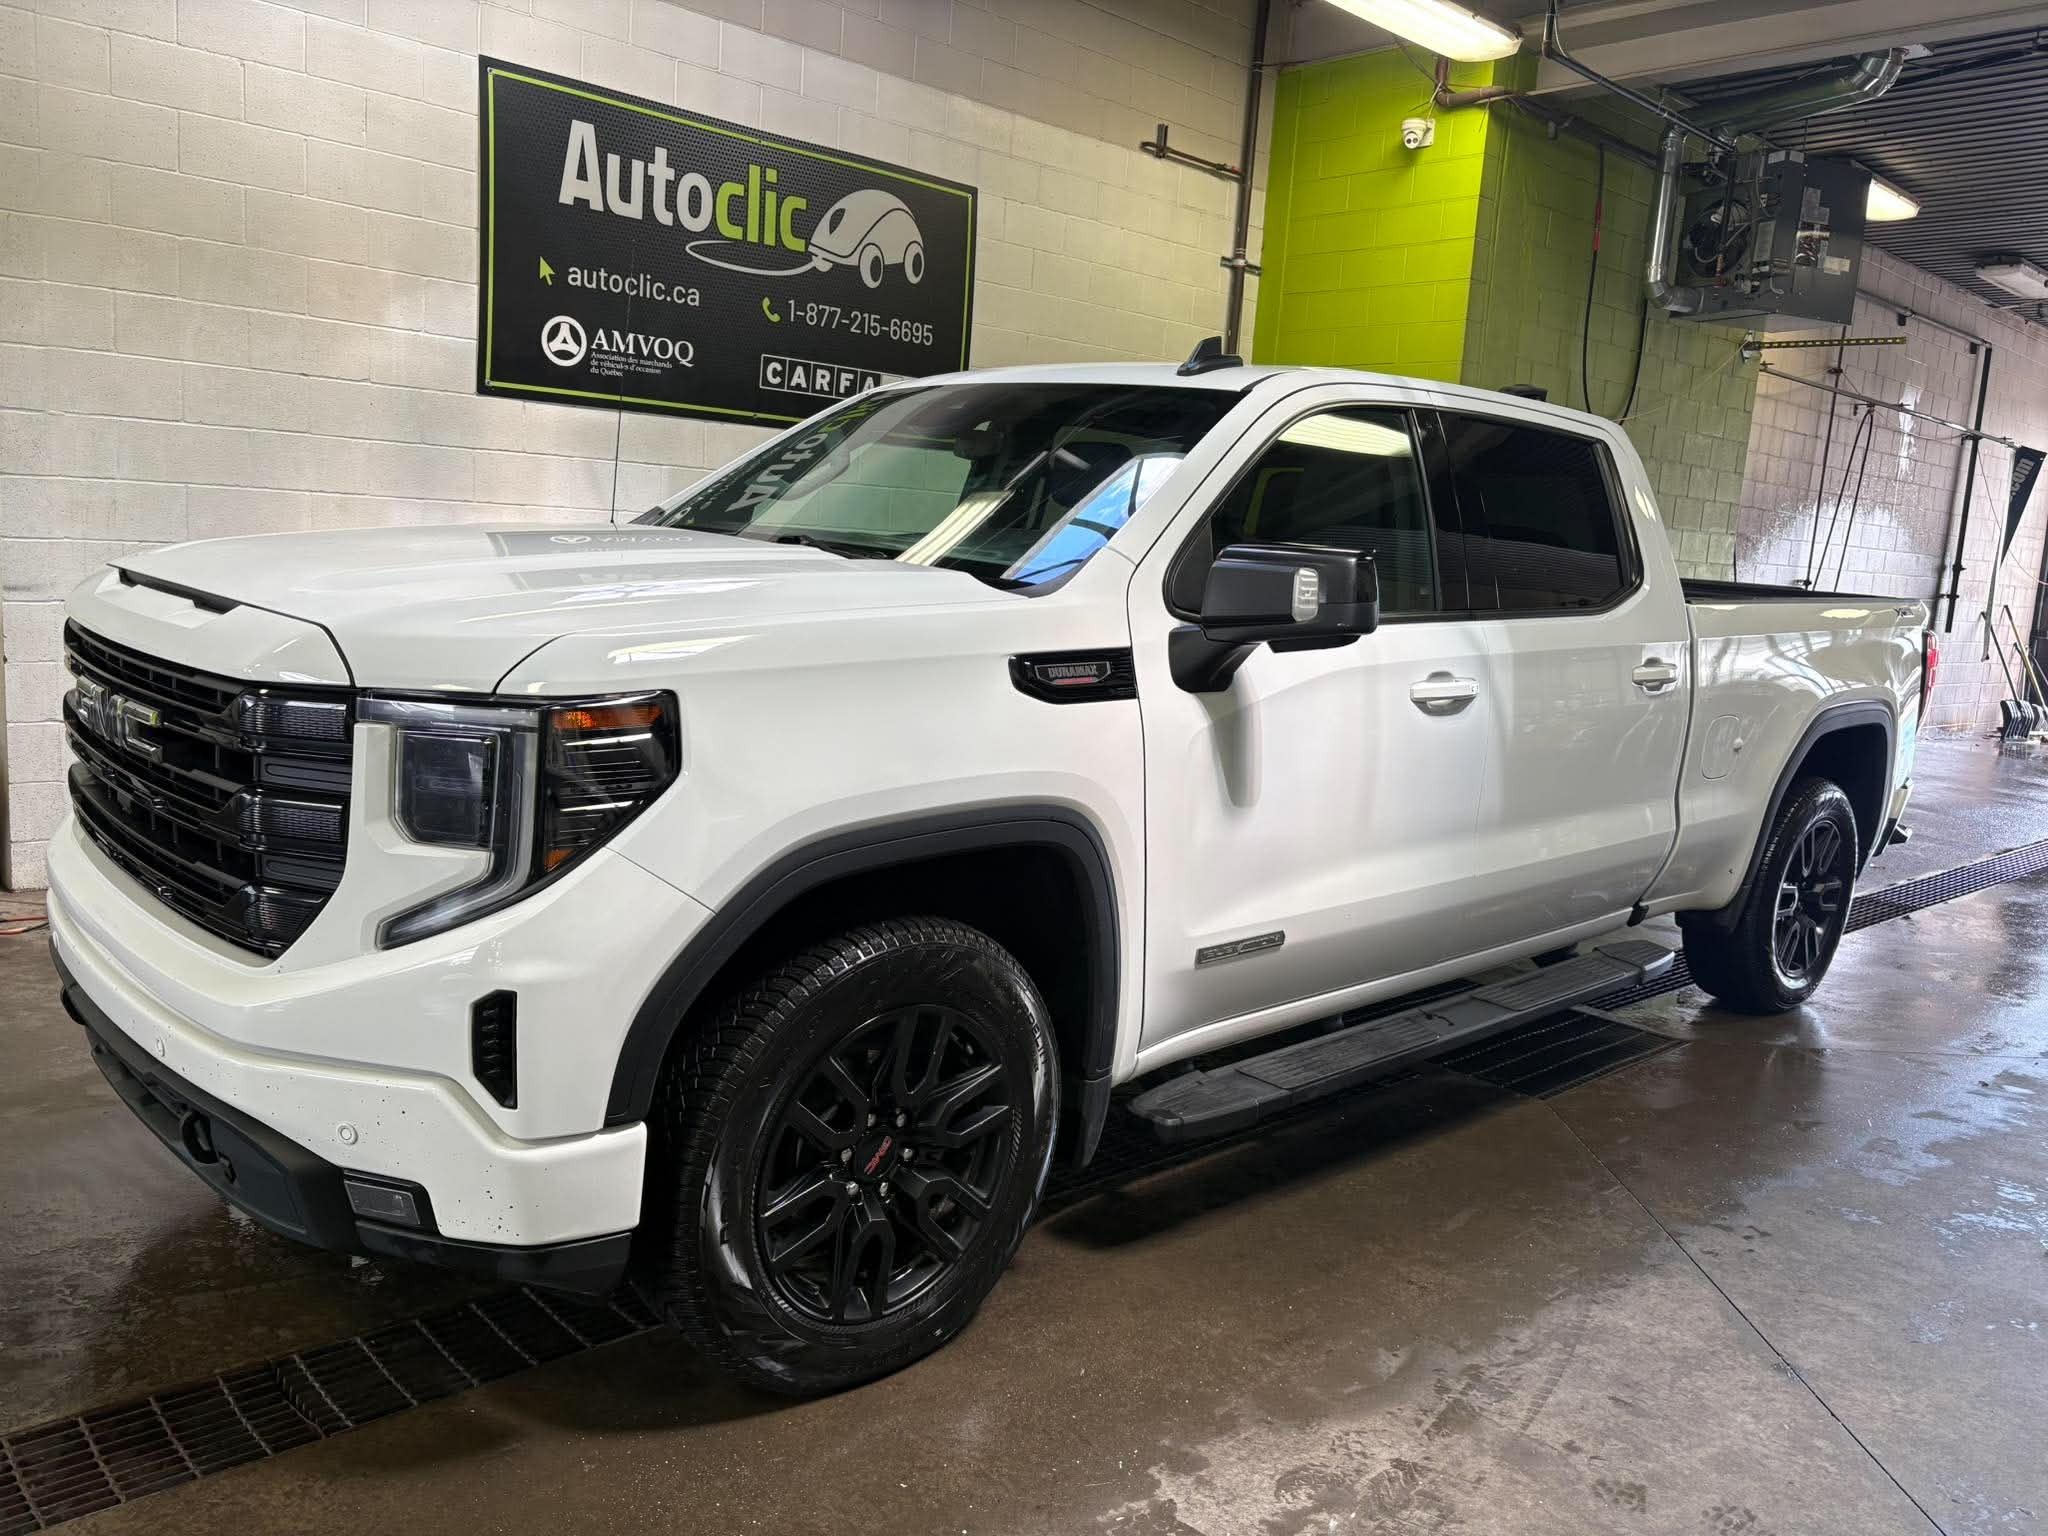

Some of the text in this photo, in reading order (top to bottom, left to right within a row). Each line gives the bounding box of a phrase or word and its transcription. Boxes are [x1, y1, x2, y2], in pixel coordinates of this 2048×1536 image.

[558, 119, 809, 252] Autoclic
[567, 266, 700, 307] autoclic.ca
[788, 299, 934, 346] 1-877-215-6695
[590, 352, 627, 363] Association
[627, 356, 638, 364] des
[591, 328, 695, 368] AMVOQ
[766, 361, 877, 395] CARFA
[1047, 663, 1099, 679] DURAMAX
